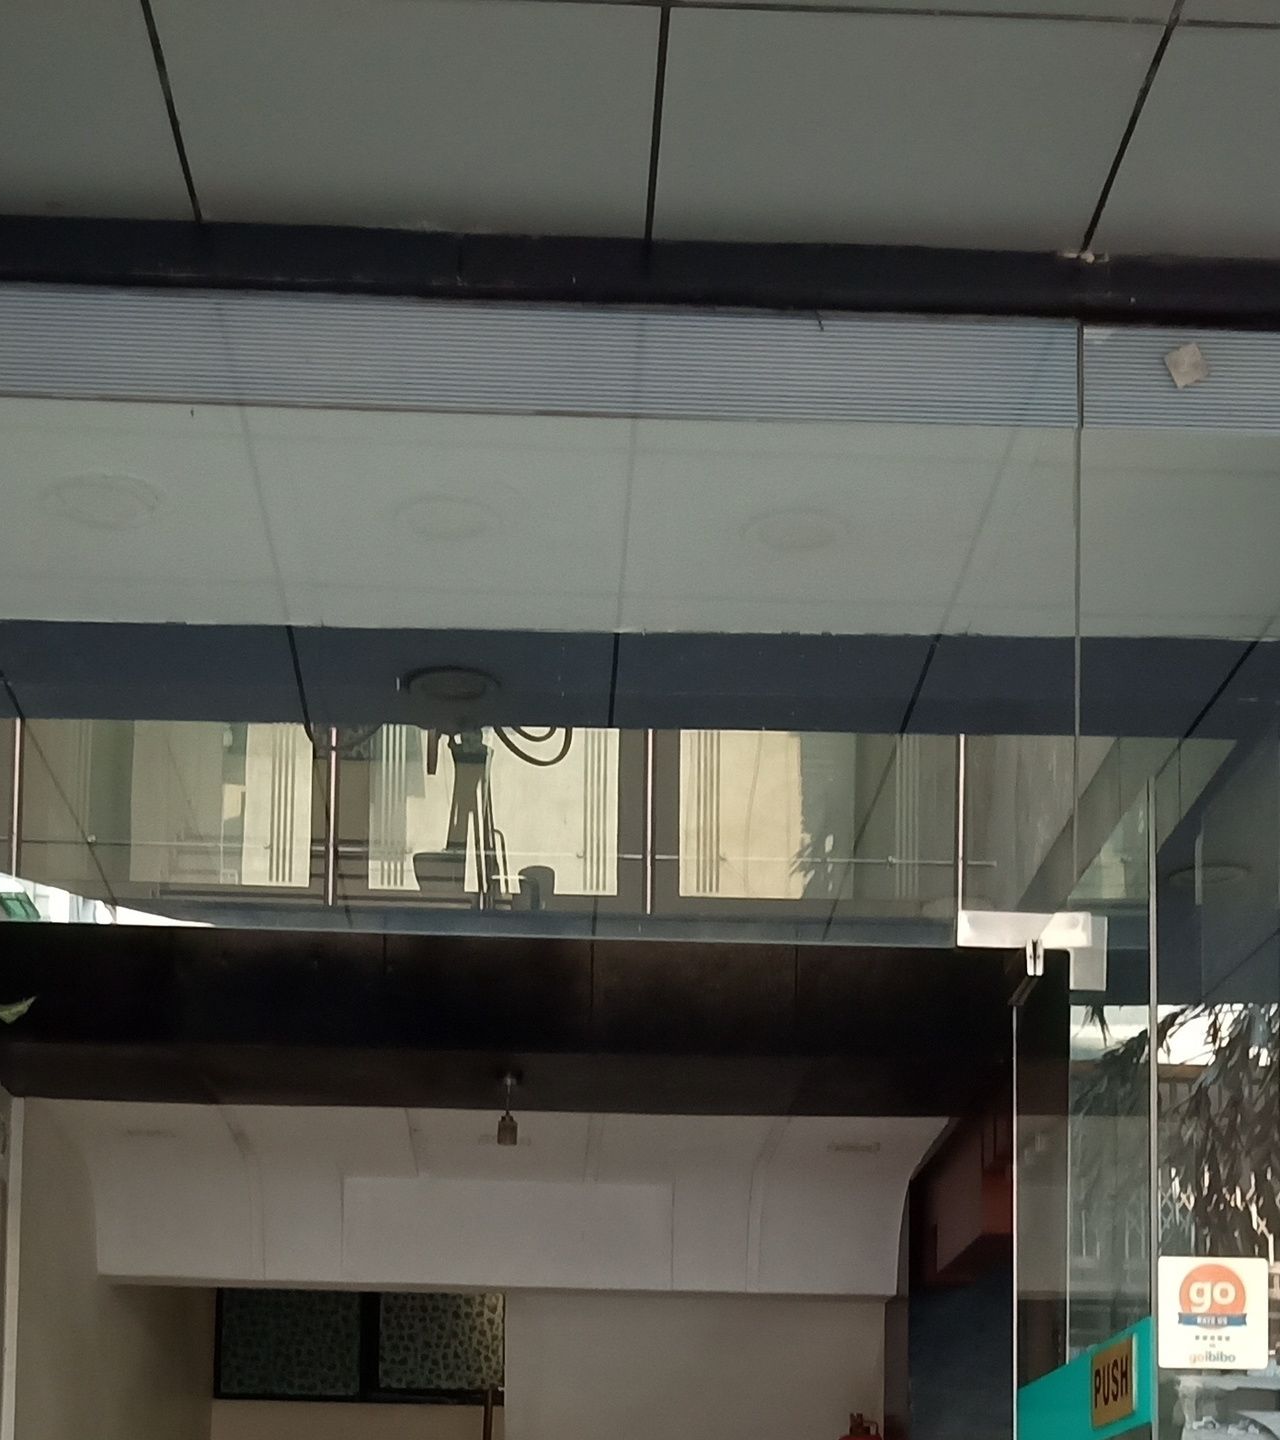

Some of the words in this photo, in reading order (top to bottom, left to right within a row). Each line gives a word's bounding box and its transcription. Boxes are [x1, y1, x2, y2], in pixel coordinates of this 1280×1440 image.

[1188, 1280, 1237, 1313] go
[1189, 1351, 1237, 1364] goibibo
[1094, 1354, 1129, 1409] PUSH
